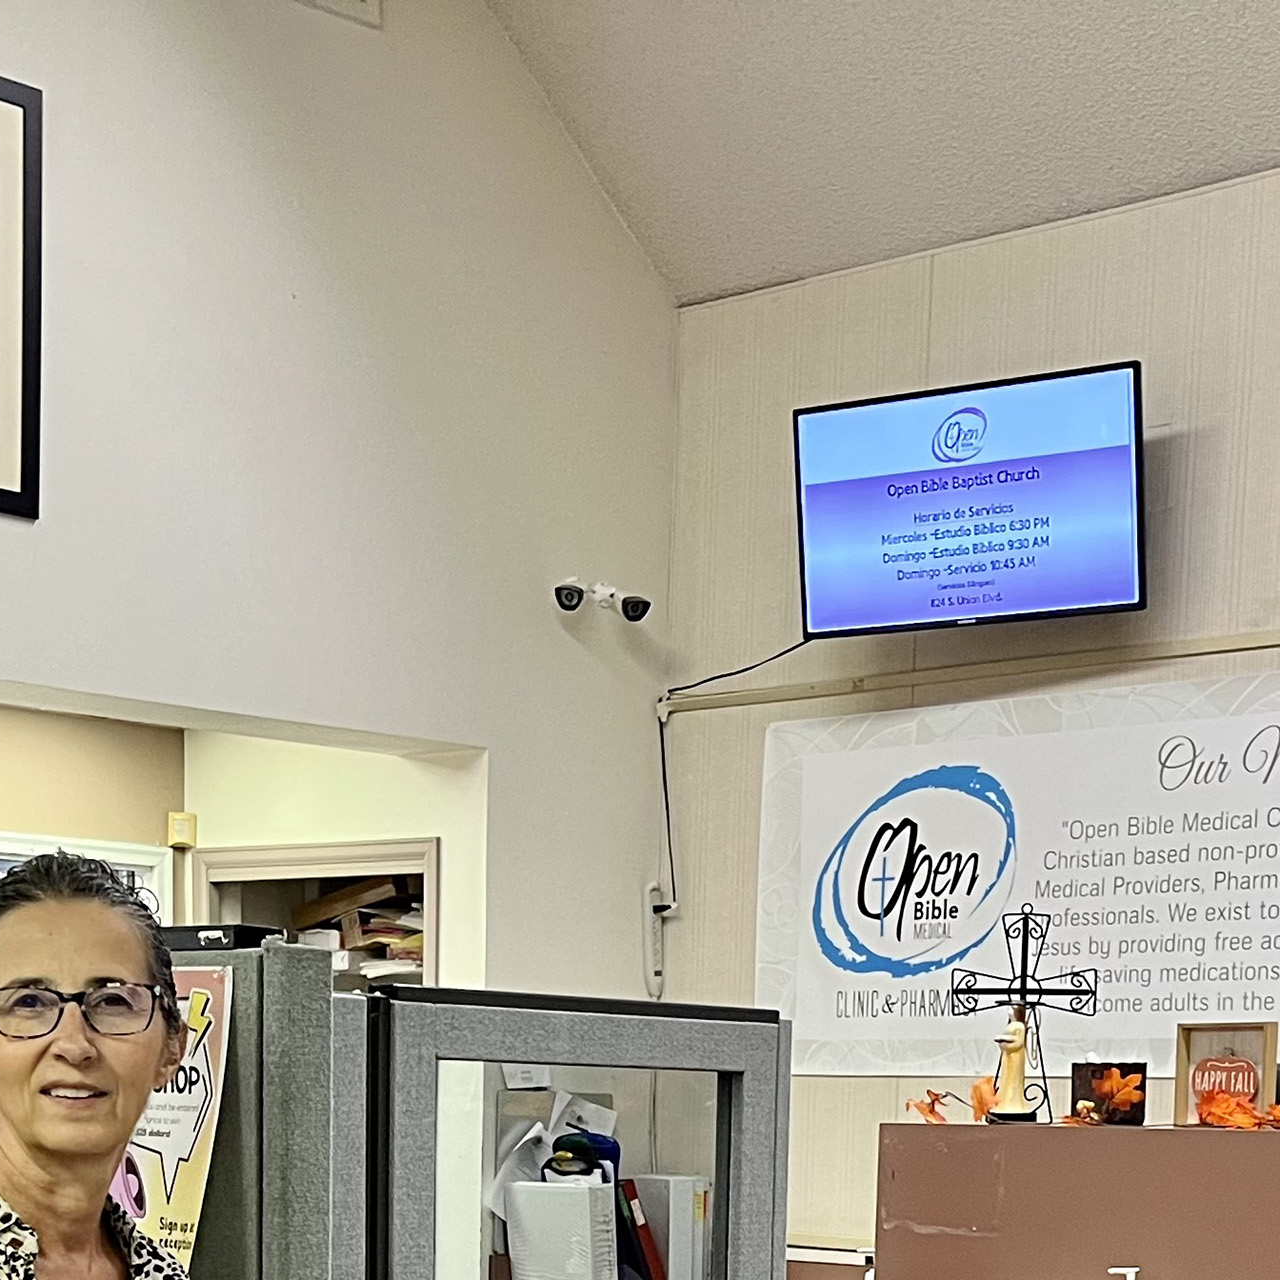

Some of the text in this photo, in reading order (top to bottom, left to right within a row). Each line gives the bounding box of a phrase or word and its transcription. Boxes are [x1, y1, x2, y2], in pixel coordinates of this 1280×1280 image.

[887, 466, 1040, 499] Open Bible Baptist Church
[914, 503, 1014, 523] Horario de Servicios
[1009, 519, 1031, 531] 6:30
[1034, 516, 1050, 529] PM
[883, 550, 926, 564] Domingo
[1007, 537, 1029, 550] 9:30
[1032, 535, 1050, 548] AM
[897, 566, 940, 581] Domingo
[990, 557, 1015, 571] 10:45
[1018, 555, 1036, 568] AM
[1158, 735, 1231, 791] Our
[1061, 819, 1120, 843] "Open
[1127, 815, 1174, 836] Bible
[1182, 808, 1258, 833] Medical
[1043, 849, 1126, 871] Christian
[1133, 843, 1190, 865] based
[857, 817, 980, 943] Open
[1034, 877, 1106, 899] Medical
[1113, 874, 1206, 896] Providers,
[913, 899, 959, 921] Bible
[1036, 904, 1160, 929] ofessionals.
[1168, 902, 1198, 923] We
[1205, 901, 1251, 921] exist
[1260, 902, 1280, 920] to
[913, 922, 953, 940] MEDICAL
[1031, 938, 1081, 958] Jesus
[1088, 936, 1110, 960] by
[1118, 933, 1206, 958] providing
[1215, 931, 1253, 951] free
[1160, 962, 1280, 983] medications
[836, 990, 901, 1018] CLINIC &
[1150, 992, 1210, 1013] adults
[1217, 991, 1234, 1012] in
[1243, 991, 1276, 1011] the
[1194, 1068, 1256, 1094] HAPPY FALL
[159, 1216, 178, 1236] Sign
